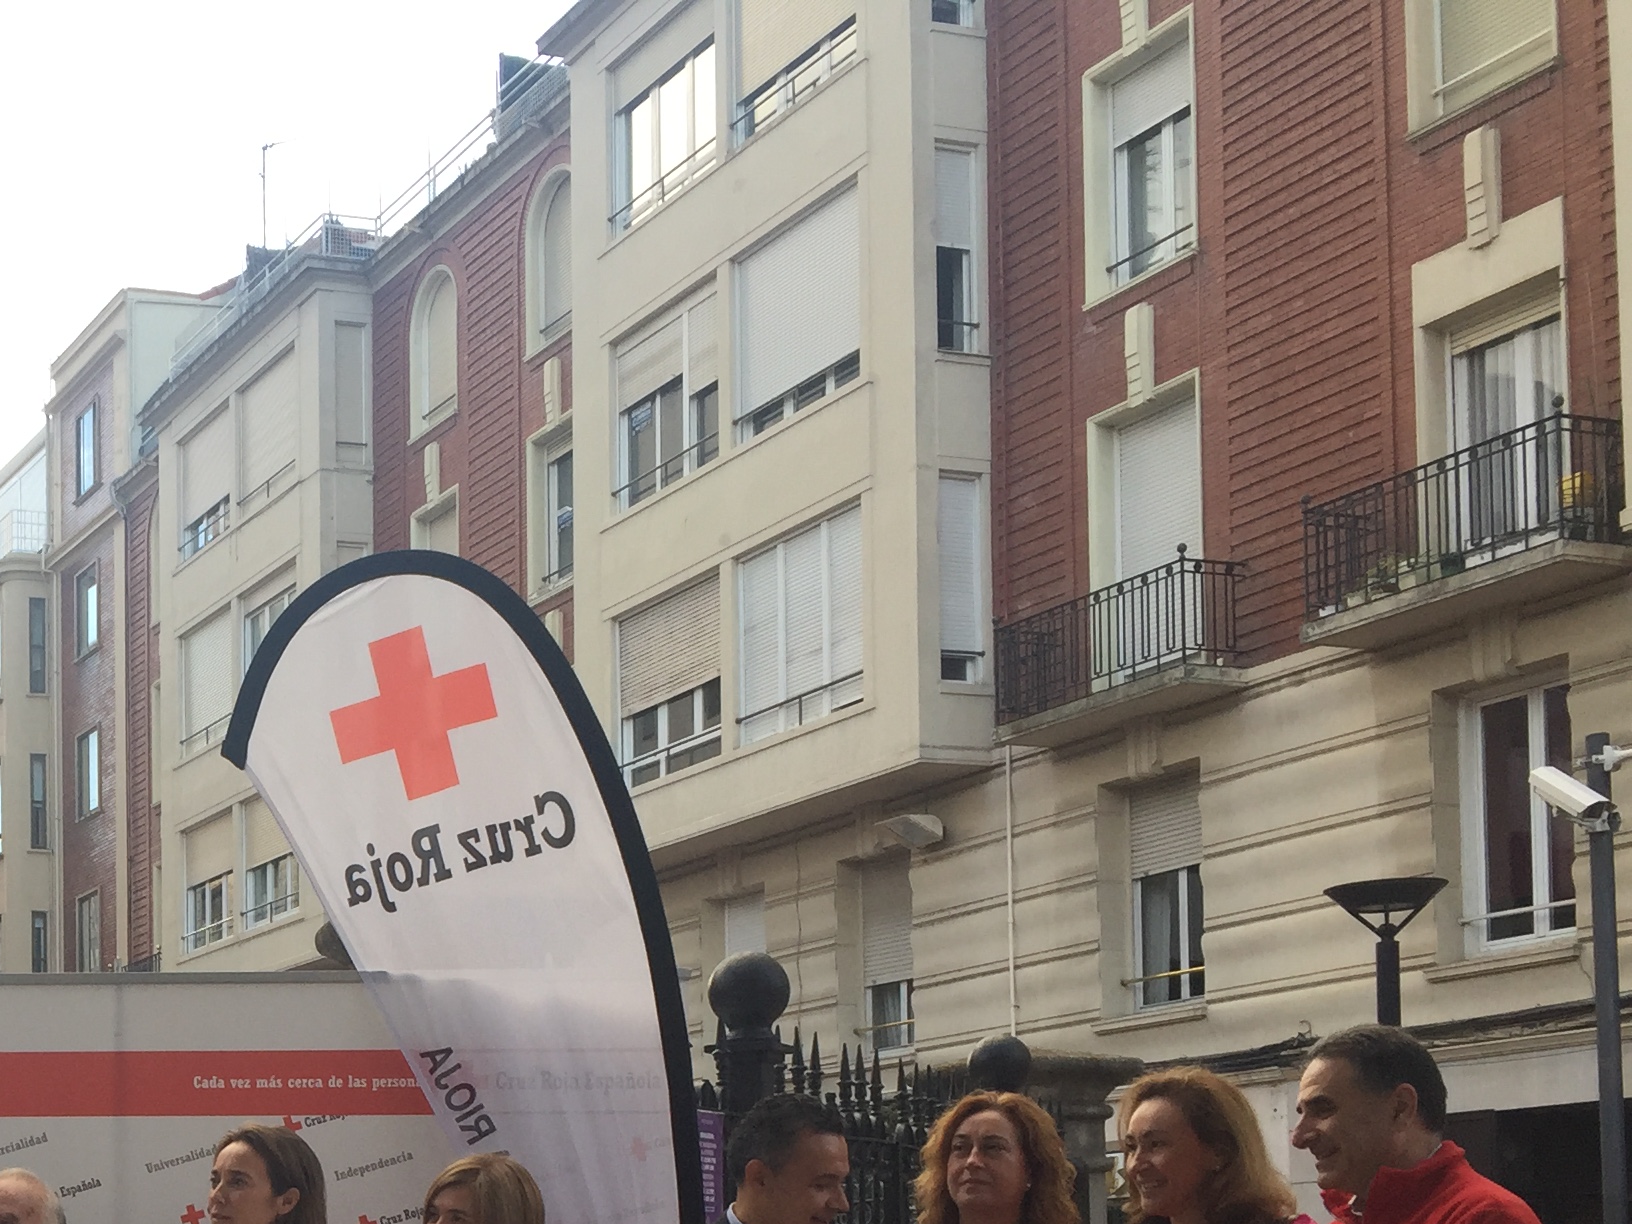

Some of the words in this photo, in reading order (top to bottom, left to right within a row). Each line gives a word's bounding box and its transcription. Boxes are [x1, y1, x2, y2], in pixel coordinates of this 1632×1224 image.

[193, 1075, 225, 1089] Cada
[230, 1078, 251, 1089] vez
[256, 1075, 283, 1089] más
[287, 1078, 323, 1089] cerca
[328, 1075, 343, 1089] de
[348, 1075, 367, 1089] las
[371, 1077, 420, 1091] person
[334, 1151, 414, 1181] Independencia
[59, 1177, 102, 1198] Española
